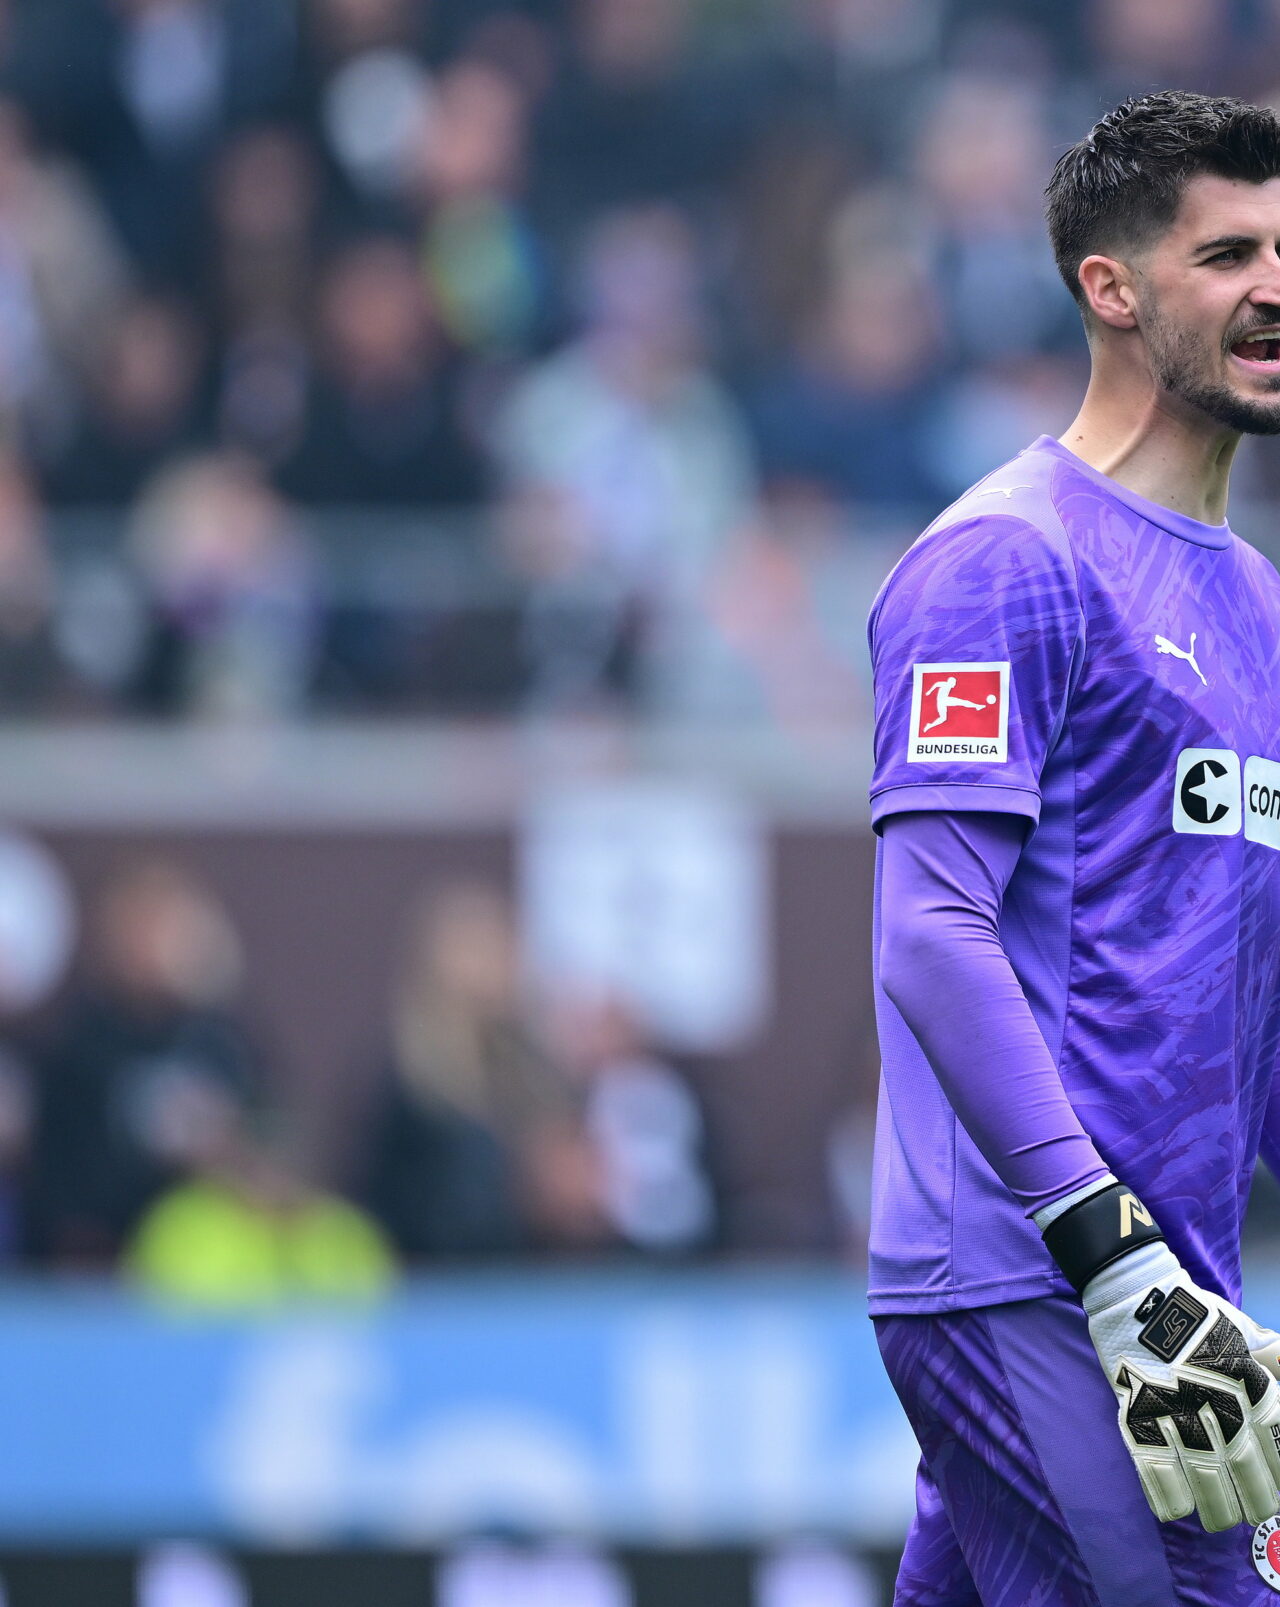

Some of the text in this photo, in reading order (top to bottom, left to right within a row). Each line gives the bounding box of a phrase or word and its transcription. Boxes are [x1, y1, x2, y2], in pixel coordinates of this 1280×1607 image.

[916, 744, 998, 755] BUNDESLIGA
[1258, 1523, 1275, 1540] ST.
[1254, 1543, 1266, 1561] FC
